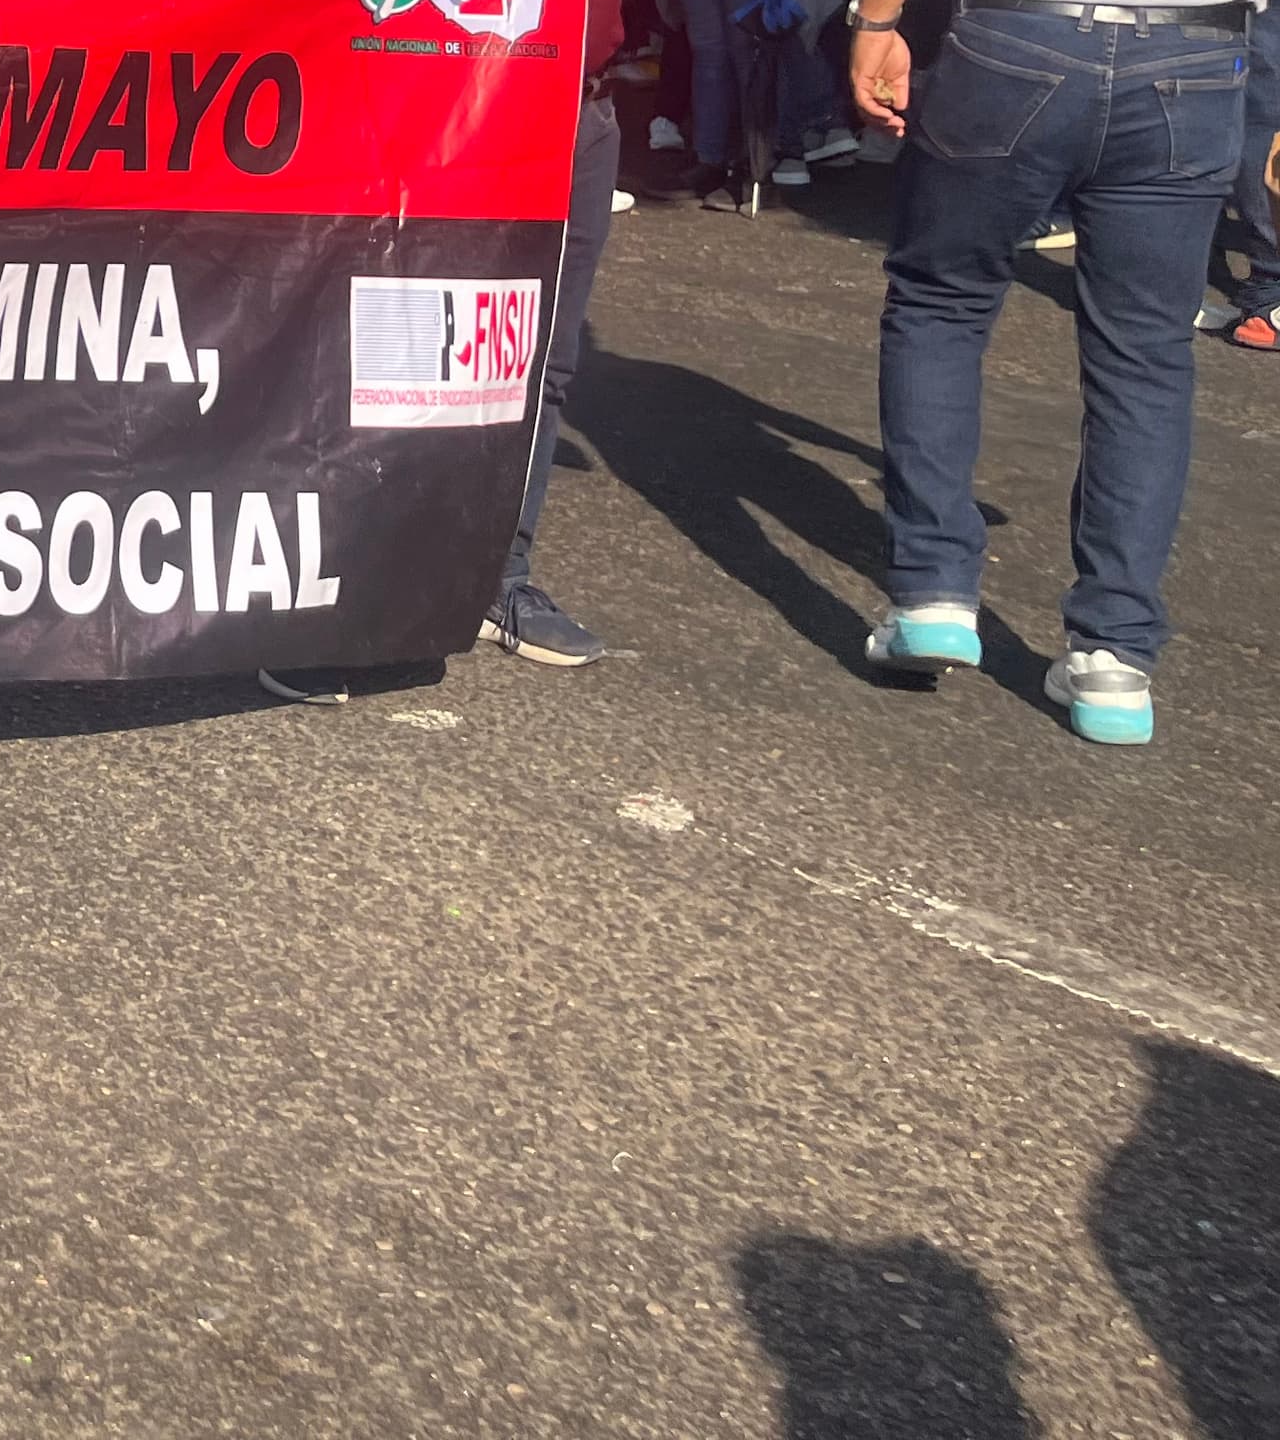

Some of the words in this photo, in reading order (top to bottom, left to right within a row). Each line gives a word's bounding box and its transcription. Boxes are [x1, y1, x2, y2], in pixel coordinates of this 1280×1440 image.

[351, 34, 381, 50] UNIÓN
[385, 39, 440, 53] NACIONAL
[445, 42, 460, 54] DE
[466, 43, 557, 57] TRABAADORES
[472, 290, 536, 382] FNSU
